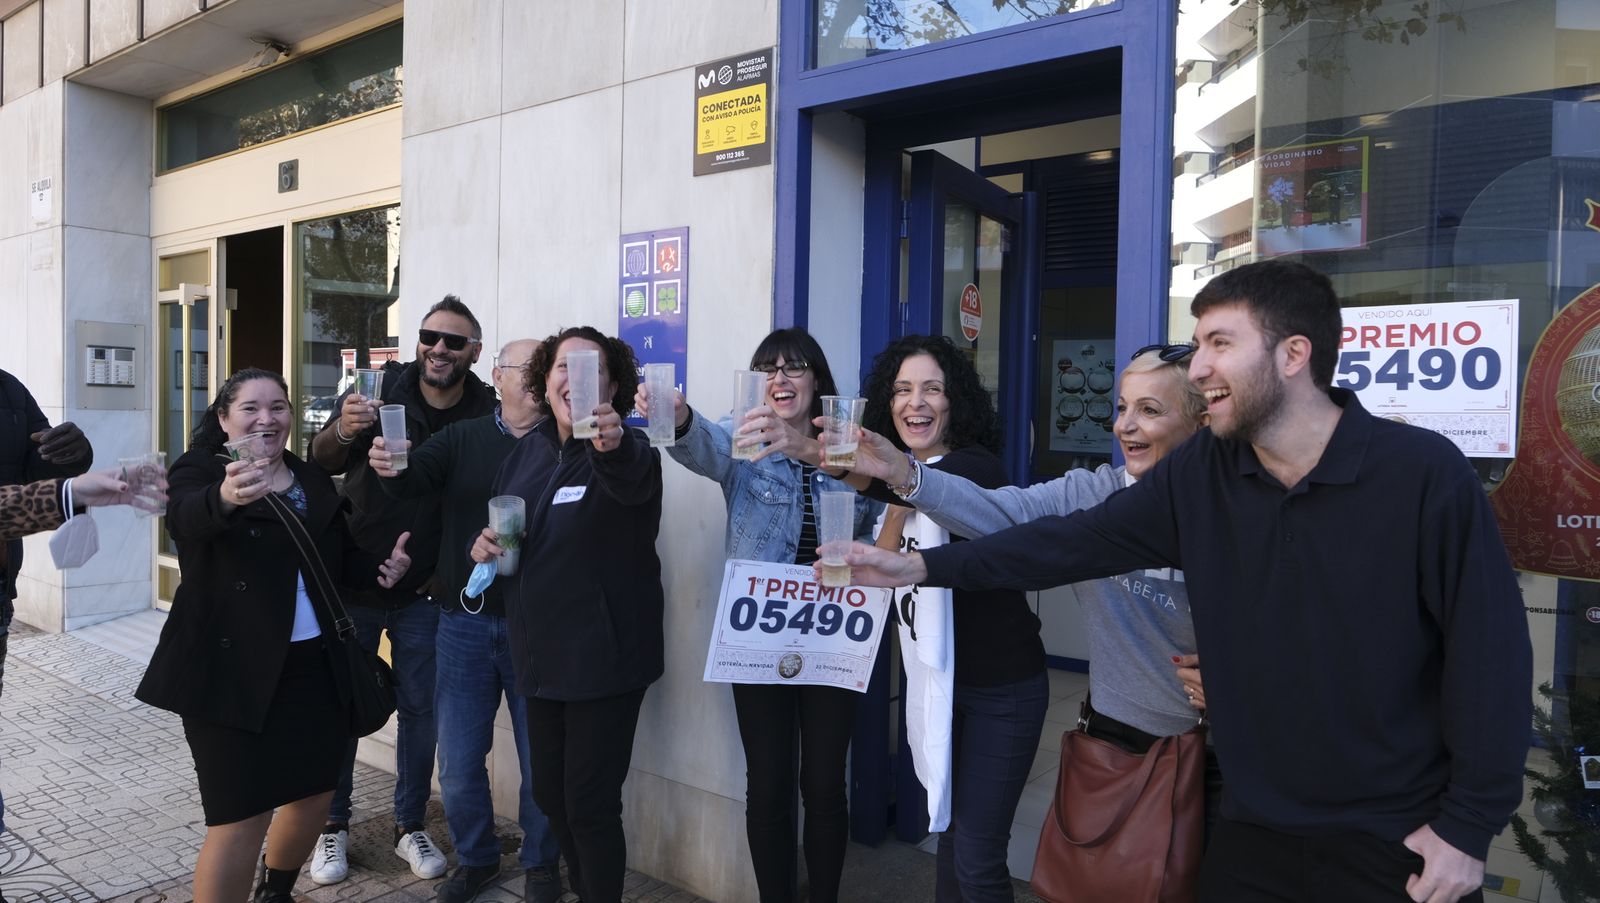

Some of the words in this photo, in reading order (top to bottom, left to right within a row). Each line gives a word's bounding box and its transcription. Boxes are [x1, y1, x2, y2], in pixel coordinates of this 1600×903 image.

[737, 56, 765, 69] MOVISTAR
[737, 63, 768, 75] PROSEGUR
[737, 71, 761, 82] ALARMAS
[702, 94, 761, 114] CONECTADA
[702, 114, 715, 123] CON
[715, 111, 733, 121] AVISO
[738, 105, 761, 116] POLICÍA
[281, 163, 293, 190] 6
[1358, 309, 1404, 319] VENDIDO
[1406, 307, 1432, 317] AQUÍ
[1339, 320, 1482, 349] PREMIO
[1336, 346, 1502, 392] 5490
[765, 578, 867, 608] PREMIO
[729, 596, 874, 642] 05490
